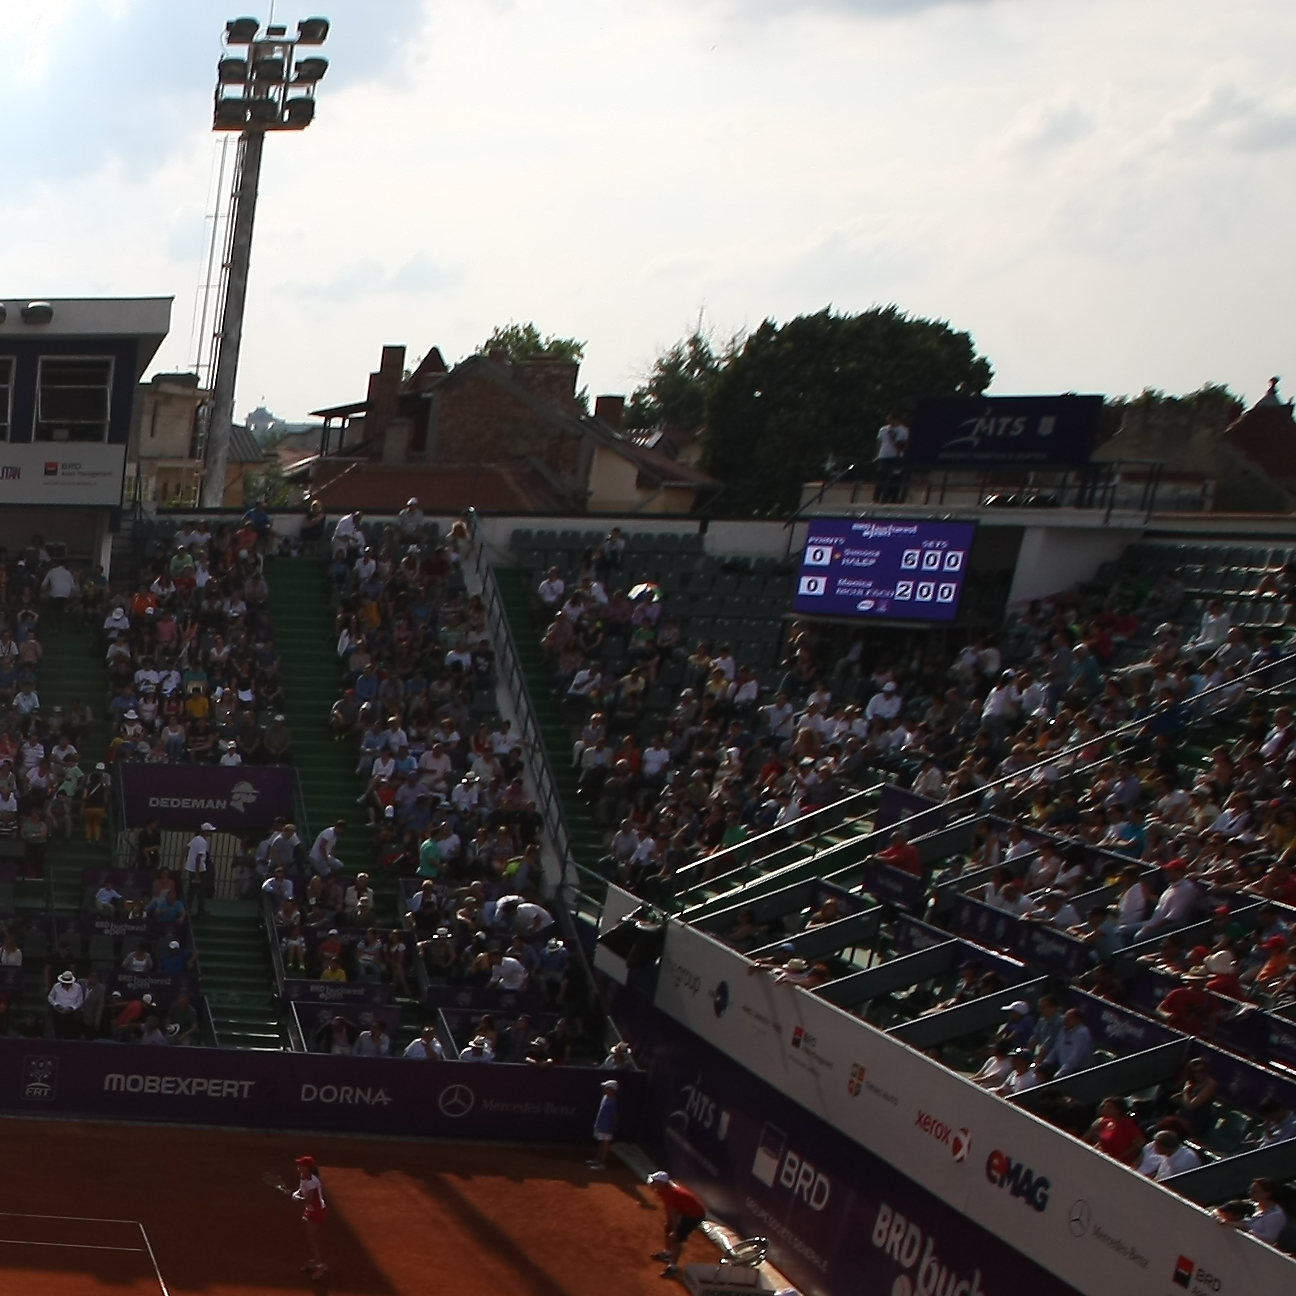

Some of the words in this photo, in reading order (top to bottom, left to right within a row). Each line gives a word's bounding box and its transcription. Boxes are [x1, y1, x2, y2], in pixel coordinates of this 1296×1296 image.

[812, 549, 824, 562] 0
[926, 553, 938, 567] 0
[947, 554, 959, 568] 0
[807, 578, 818, 592] 0
[897, 583, 911, 597] 2
[919, 585, 932, 599] 0
[940, 586, 953, 600] 0
[148, 797, 227, 810] DEDEMAN
[24, 1086, 52, 1097] FRT
[103, 1073, 256, 1099] MOBEXPERT
[300, 1084, 393, 1106] DORNA
[481, 1098, 577, 1116] Mercedes-Benz
[914, 1109, 953, 1145] xerox
[779, 1150, 831, 1212] BRD
[985, 1149, 1051, 1213] eMAG
[872, 1201, 922, 1269] BRD
[1195, 1268, 1223, 1293] BRD
